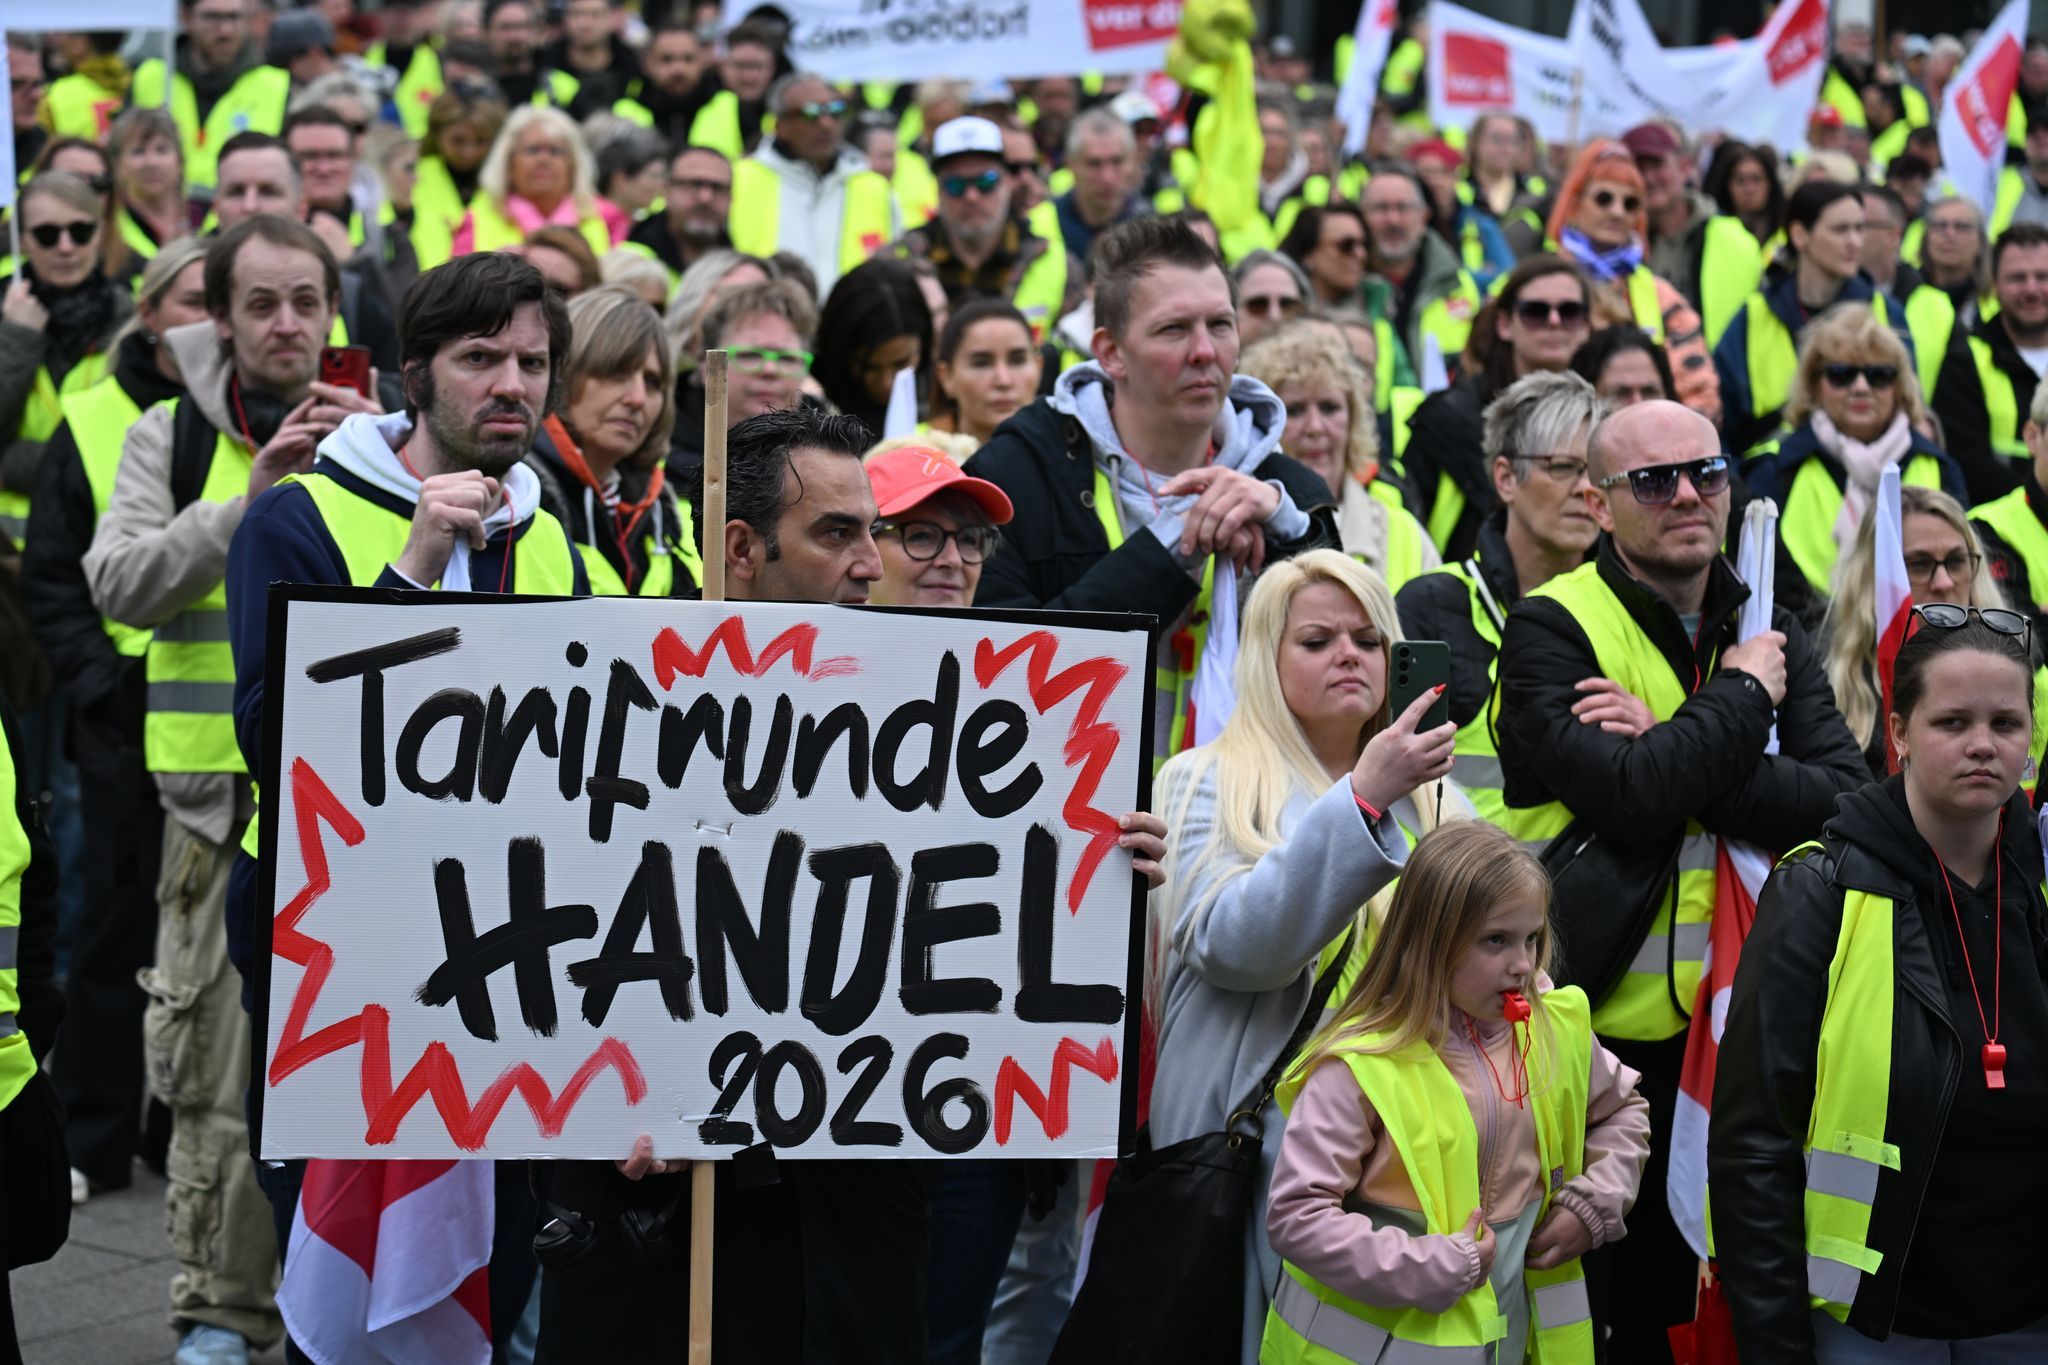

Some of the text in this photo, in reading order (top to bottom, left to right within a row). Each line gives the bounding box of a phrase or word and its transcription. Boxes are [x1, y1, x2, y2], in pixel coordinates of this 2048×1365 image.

[306, 627, 1044, 843] Tarifrunde
[415, 823, 1126, 1043] HANDEL
[697, 1030, 992, 1155] 2026
